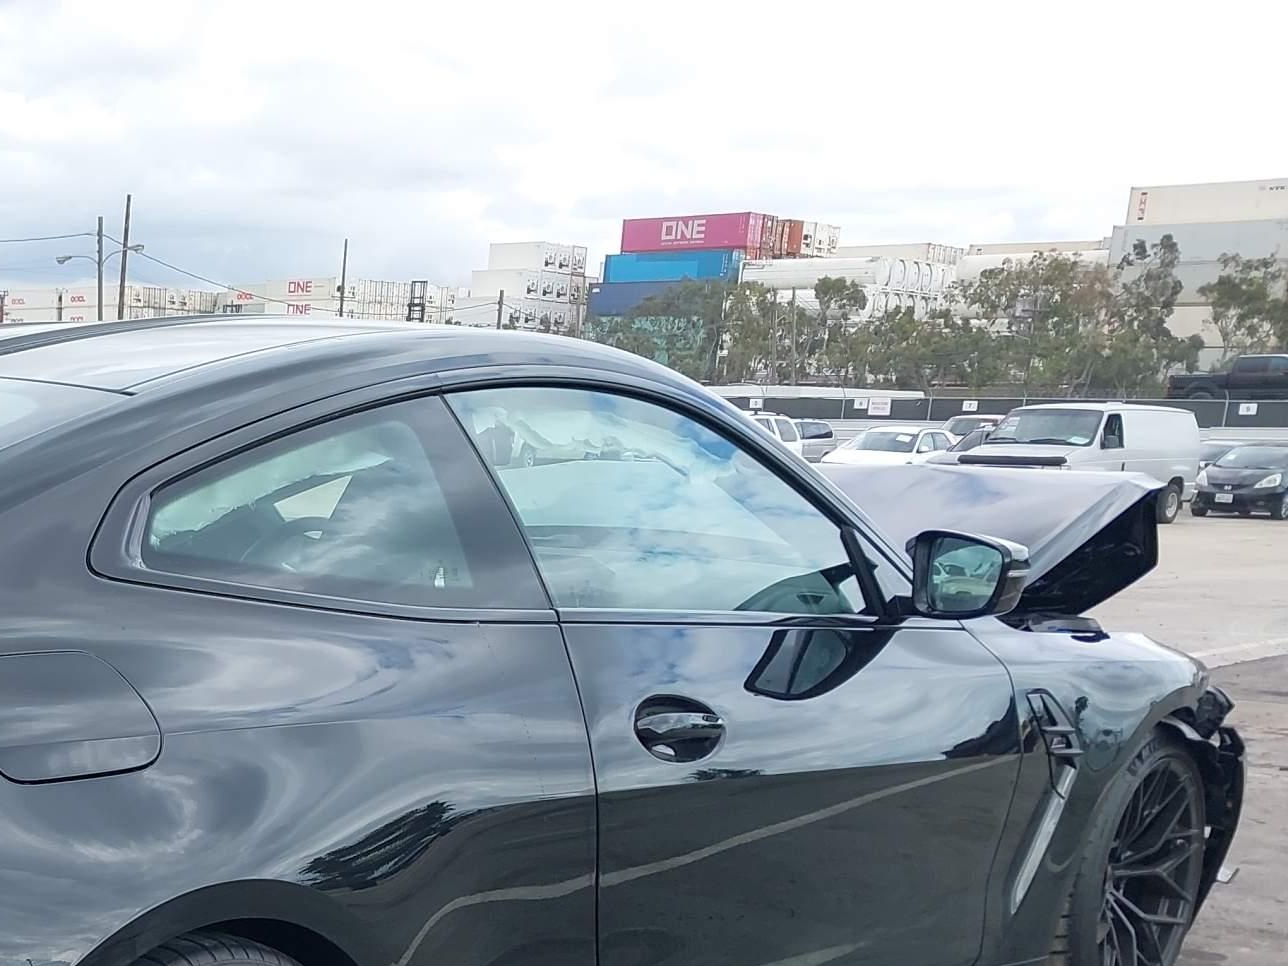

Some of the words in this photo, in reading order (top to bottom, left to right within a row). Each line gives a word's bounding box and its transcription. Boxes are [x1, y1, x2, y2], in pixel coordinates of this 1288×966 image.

[661, 219, 706, 241] ONE
[288, 281, 312, 293] ONE
[287, 303, 311, 315] ONE
